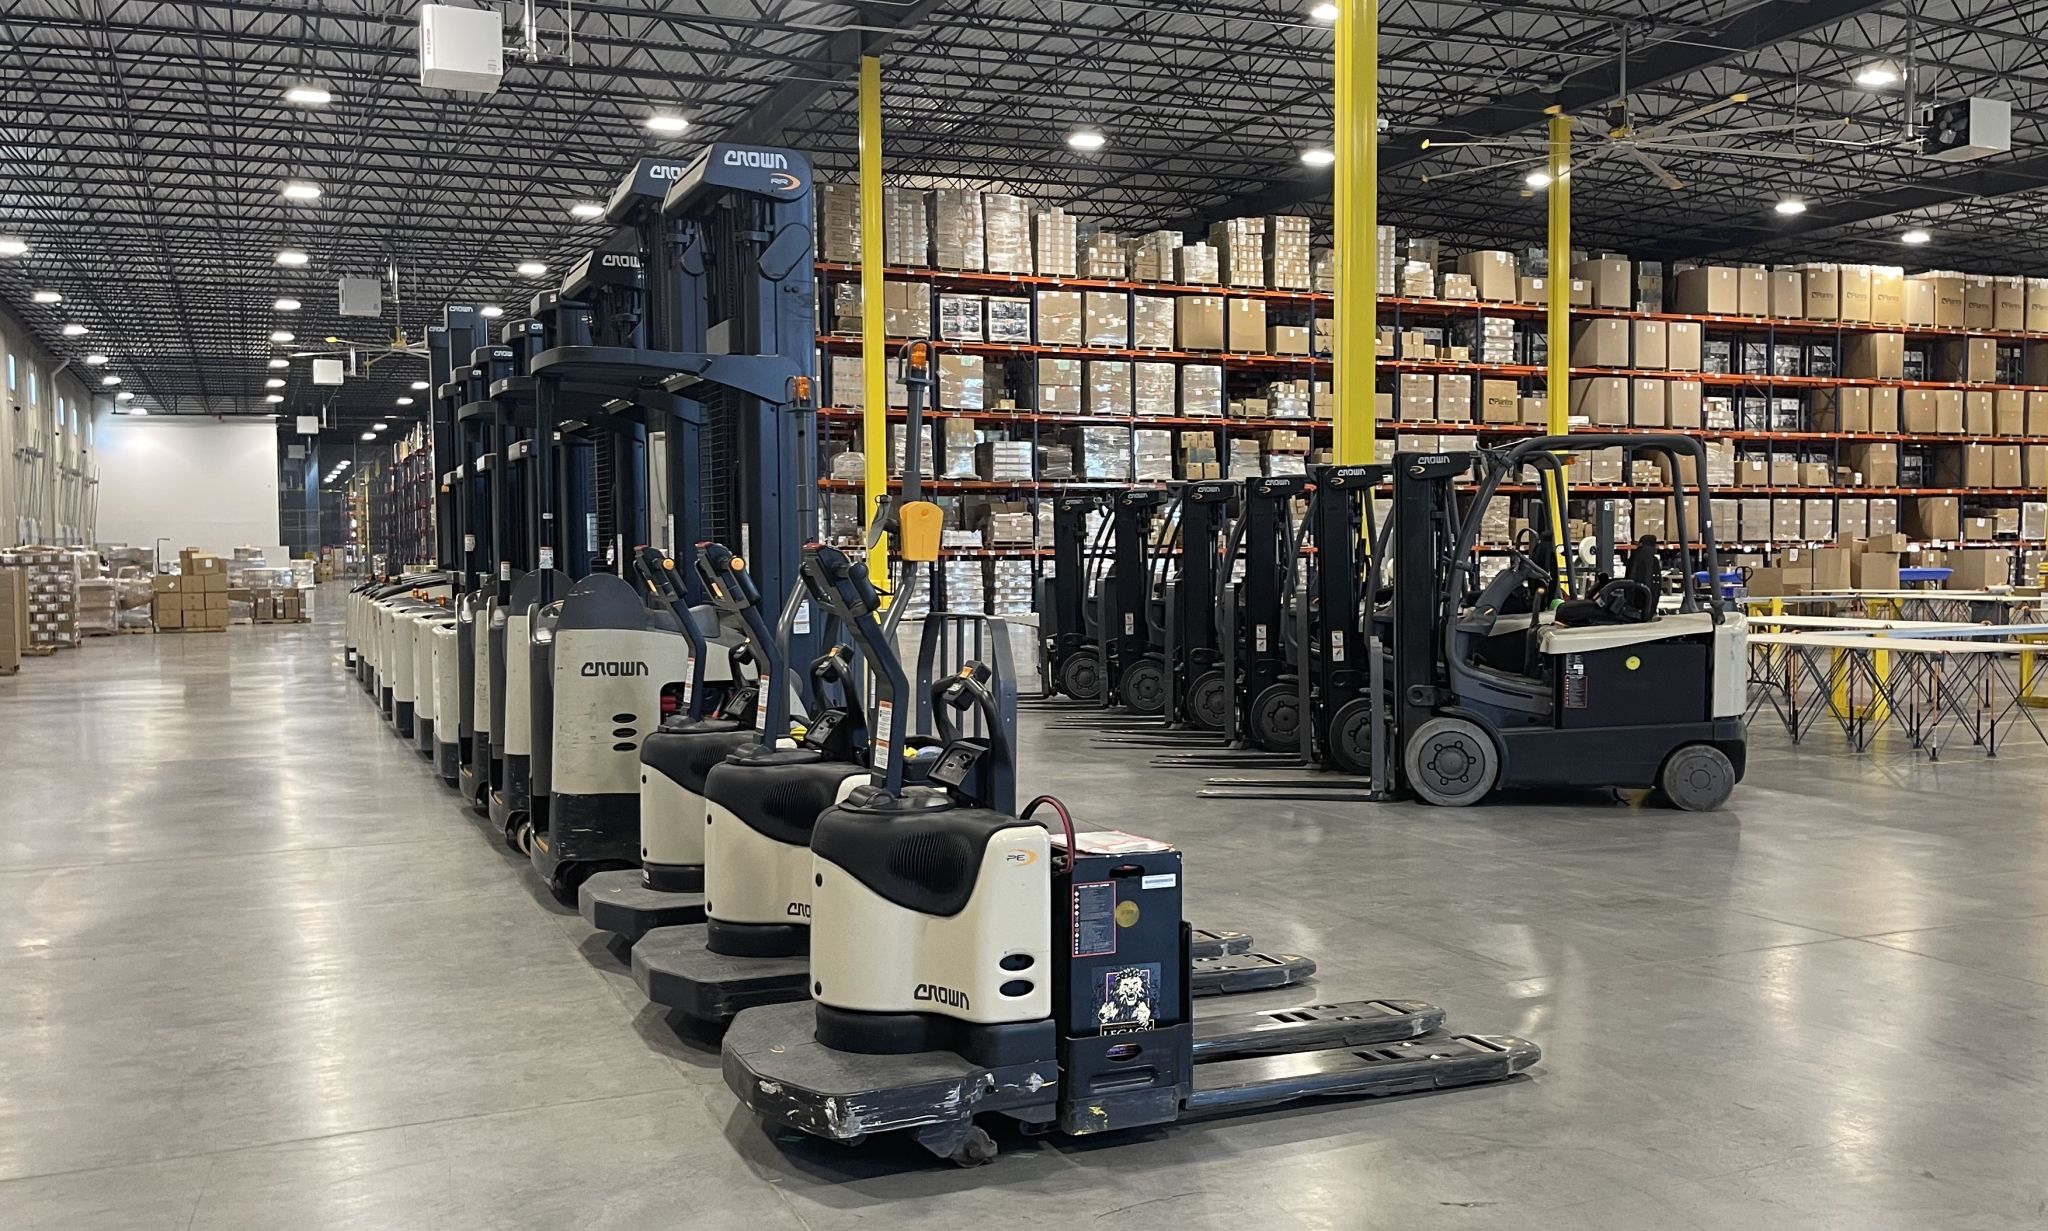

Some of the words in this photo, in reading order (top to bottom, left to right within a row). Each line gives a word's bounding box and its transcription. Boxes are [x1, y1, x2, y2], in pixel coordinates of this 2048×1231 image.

[724, 150, 788, 169] CROWN
[650, 165, 685, 180] CRO
[602, 254, 644, 268] CROW
[1417, 455, 1450, 465] CROWN
[1337, 468, 1366, 476] CROWN
[581, 661, 649, 677] CROWN
[787, 902, 811, 918] CRO
[913, 983, 970, 1011] CROWN
